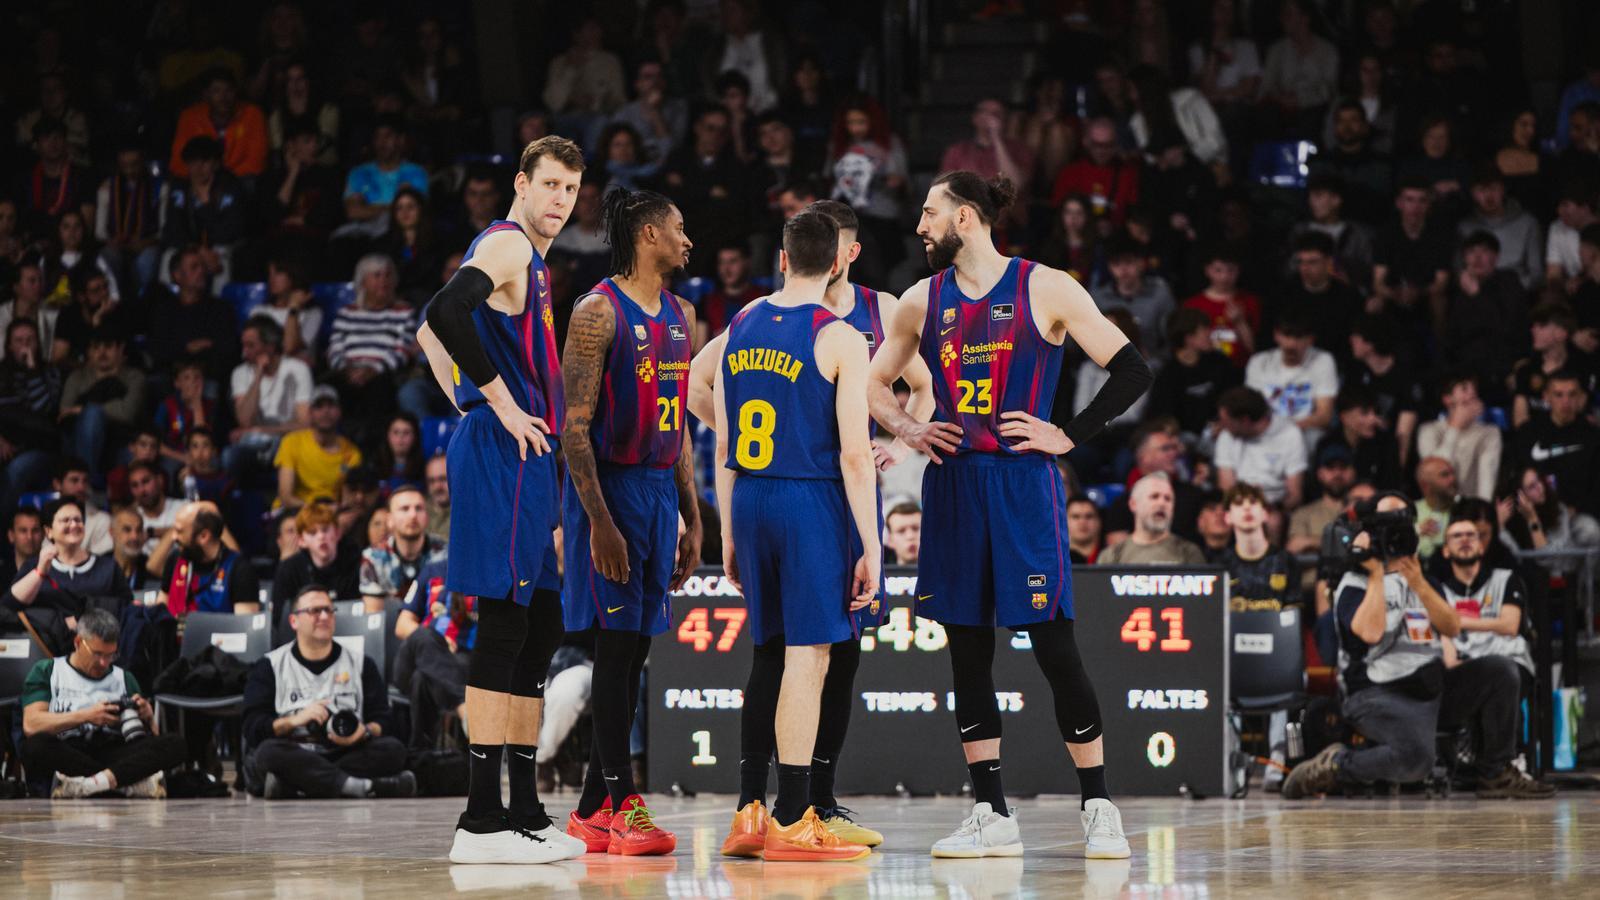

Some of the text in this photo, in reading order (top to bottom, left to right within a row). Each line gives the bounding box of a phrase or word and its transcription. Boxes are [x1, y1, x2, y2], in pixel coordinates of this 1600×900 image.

[727, 347, 803, 384] BRIZUELA
[656, 396, 680, 432] 21
[956, 378, 992, 415] 23
[735, 399, 776, 470] 8
[1110, 575, 1217, 596] VISITANT
[677, 607, 748, 652] 47
[1120, 606, 1193, 652] 41
[664, 688, 744, 709] FALTES
[861, 691, 937, 712] TEMPS
[1127, 689, 1209, 710] FALTES
[691, 730, 717, 766] 1
[1146, 731, 1176, 768] 0
